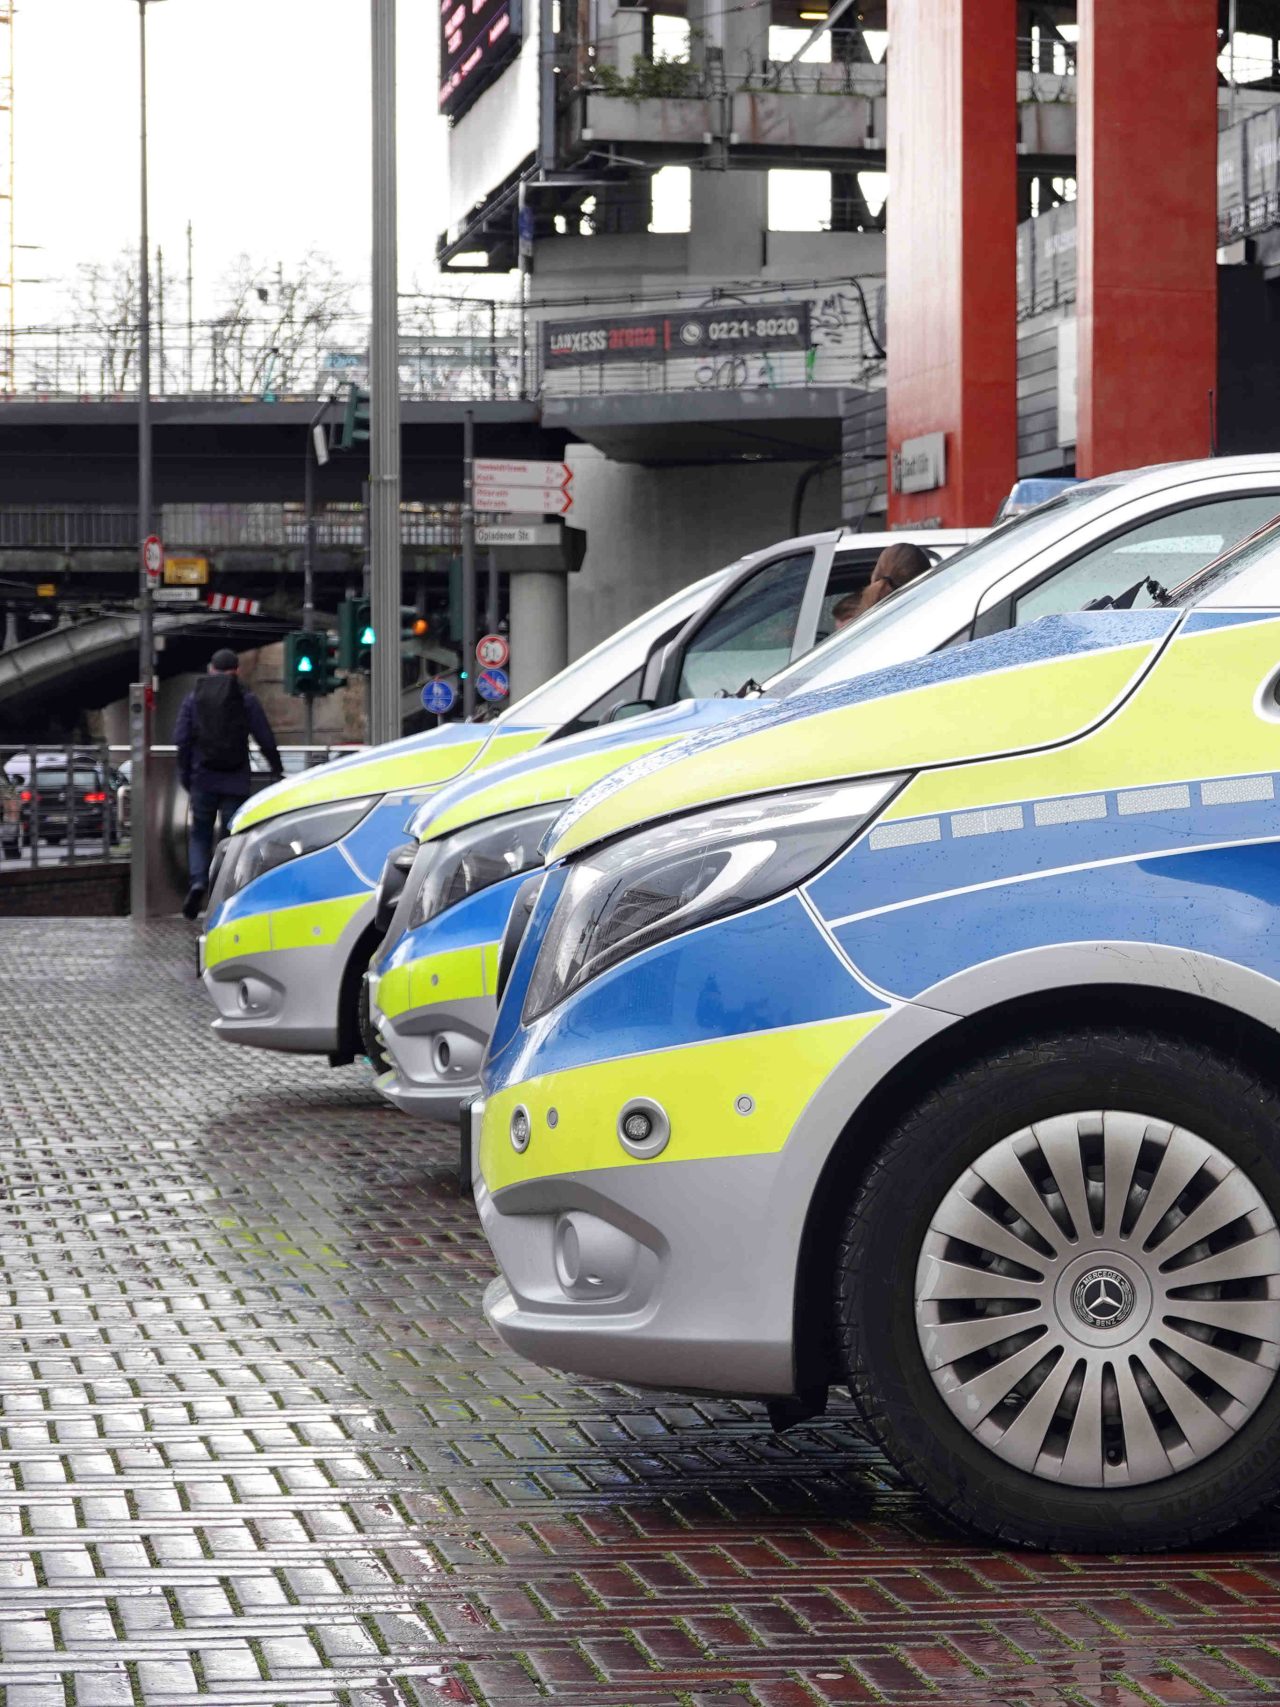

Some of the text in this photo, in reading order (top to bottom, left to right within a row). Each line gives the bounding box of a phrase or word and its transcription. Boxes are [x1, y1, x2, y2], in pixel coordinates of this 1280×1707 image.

[550, 331, 607, 353] LANXESS
[608, 327, 657, 349] arena
[1082, 1270, 1122, 1285] MERCEDES
[1095, 1317, 1118, 1327] BENZ
